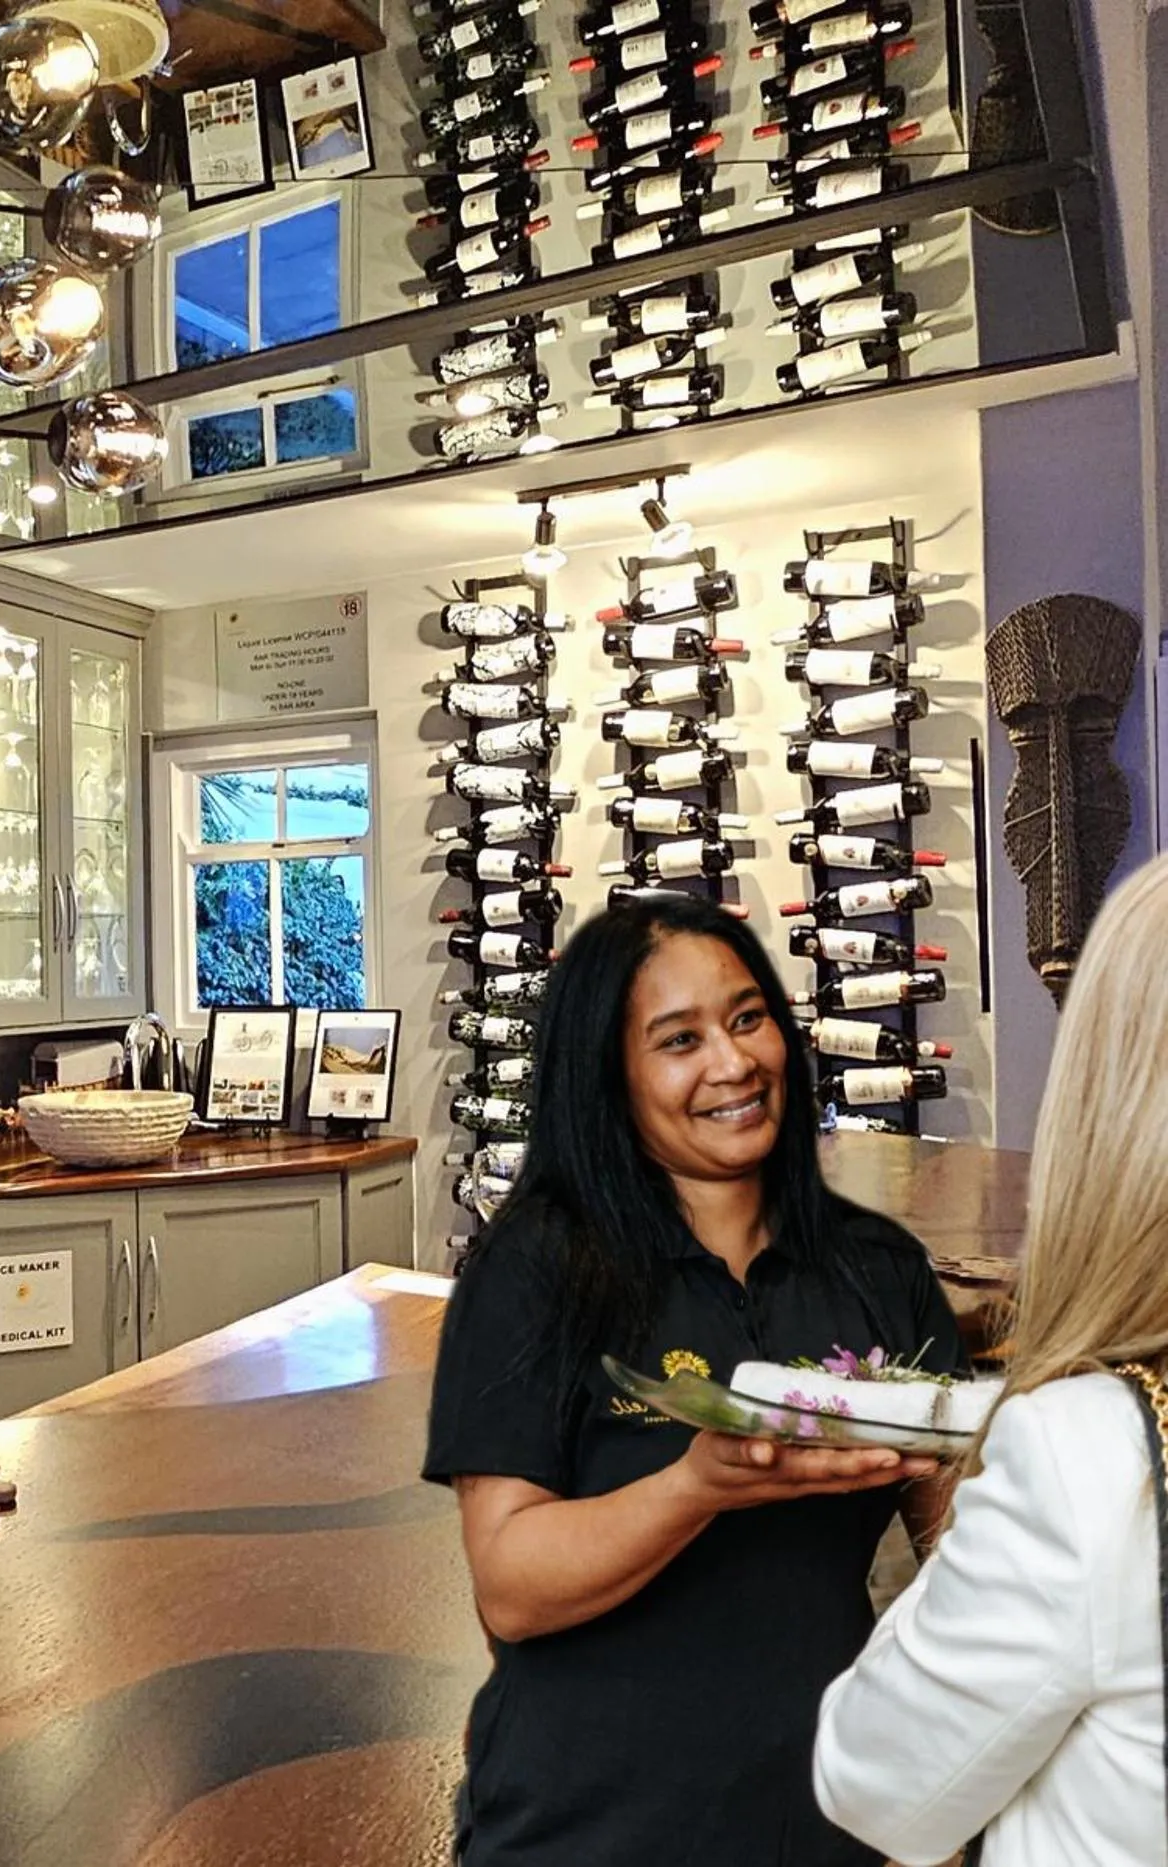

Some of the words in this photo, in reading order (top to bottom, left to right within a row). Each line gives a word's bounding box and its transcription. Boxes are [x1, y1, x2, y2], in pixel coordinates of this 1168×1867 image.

[343, 601, 358, 616] 18
[19, 1261, 60, 1272] MAKER
[46, 1327, 65, 1338] KIT
